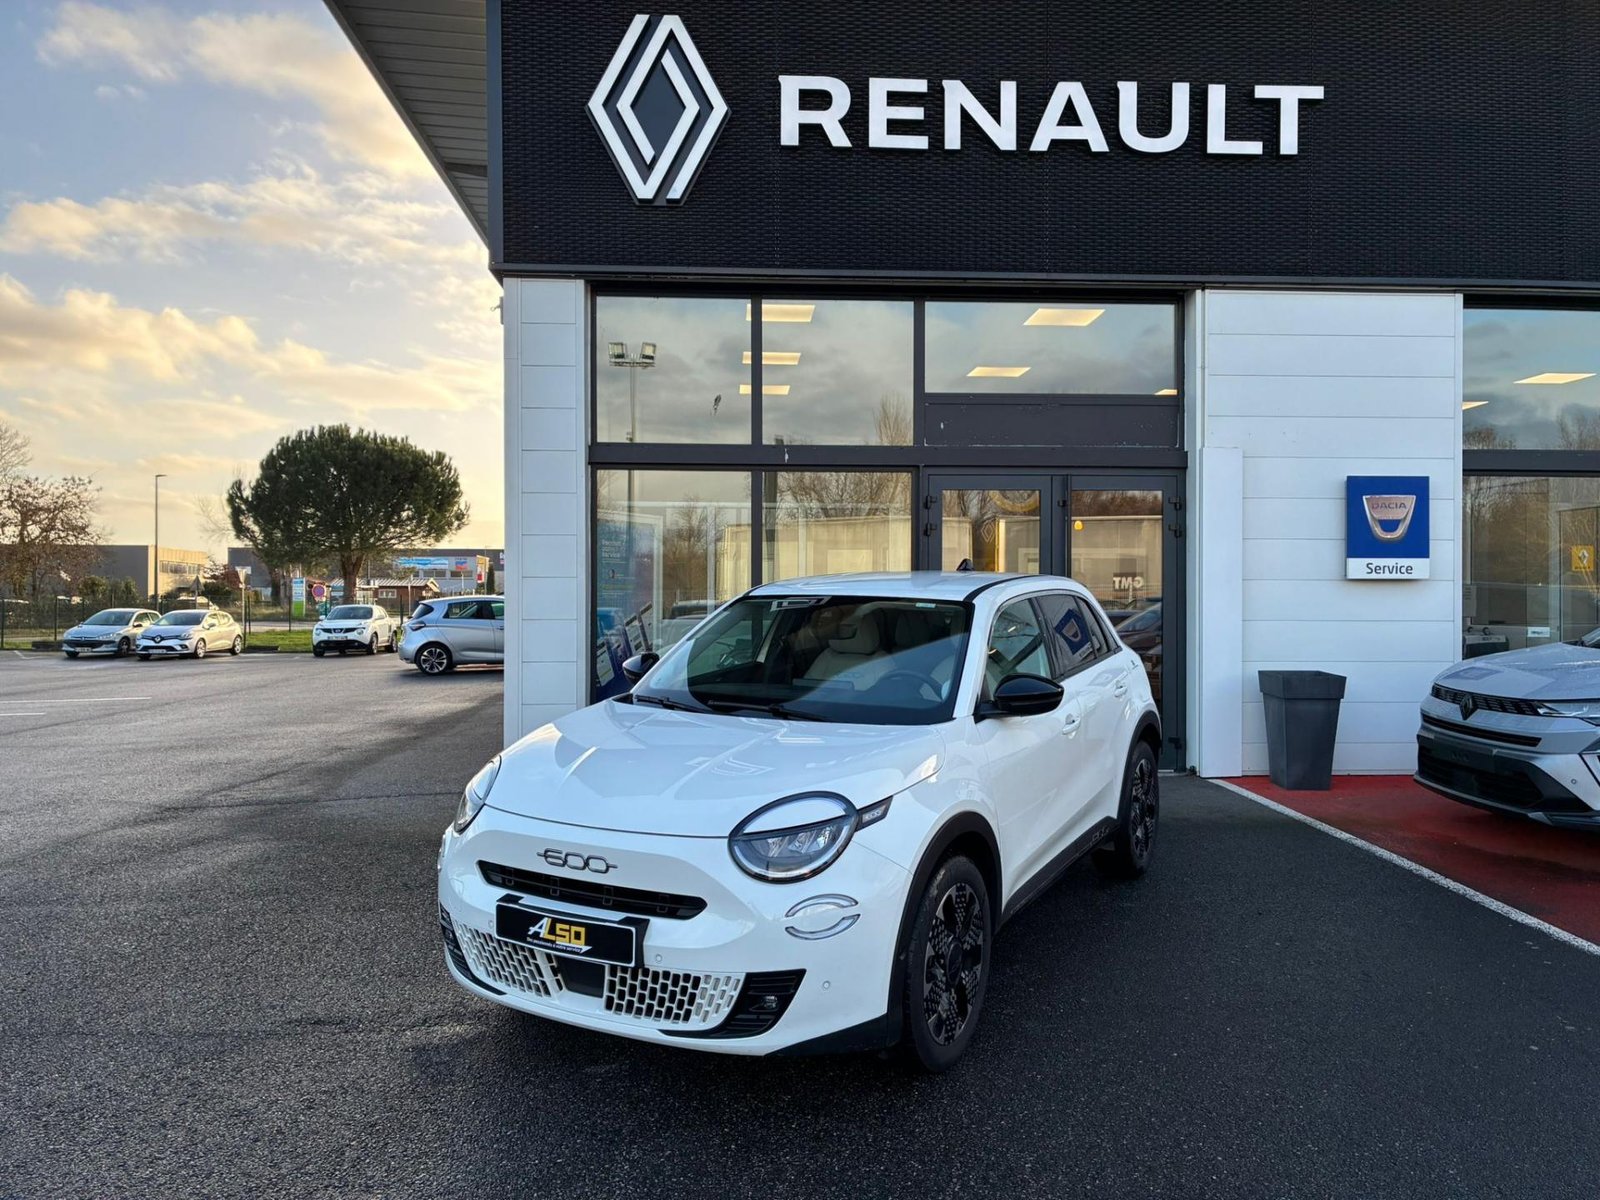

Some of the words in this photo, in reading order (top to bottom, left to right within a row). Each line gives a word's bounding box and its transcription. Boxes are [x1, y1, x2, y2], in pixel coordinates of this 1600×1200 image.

[778, 75, 1325, 156] RENAULT
[1371, 502, 1407, 510] DACIA
[1366, 562, 1413, 575] Service
[536, 848, 618, 874] 600
